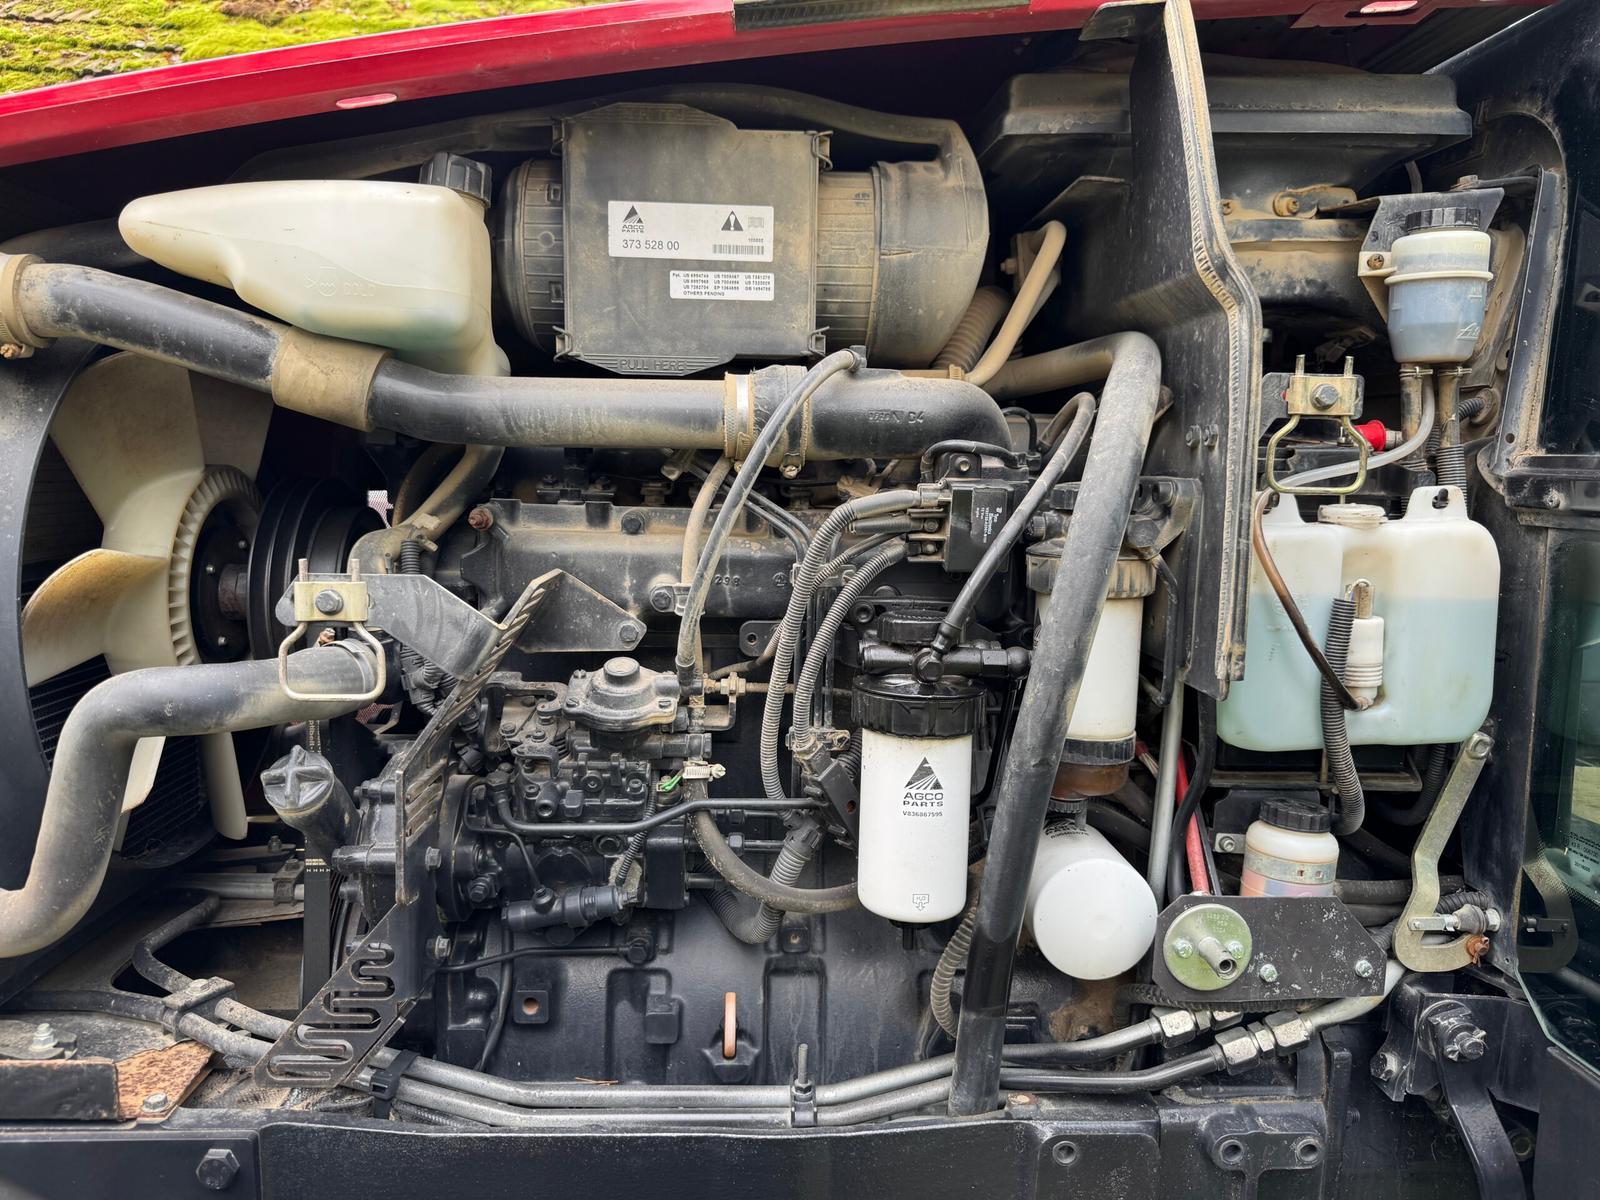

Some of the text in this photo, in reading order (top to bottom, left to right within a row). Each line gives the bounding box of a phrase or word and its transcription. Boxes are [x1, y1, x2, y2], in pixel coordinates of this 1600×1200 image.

[622, 239, 680, 251] 373 528 00
[620, 359, 686, 371] PULL HERE
[903, 792, 944, 801] AGCO
